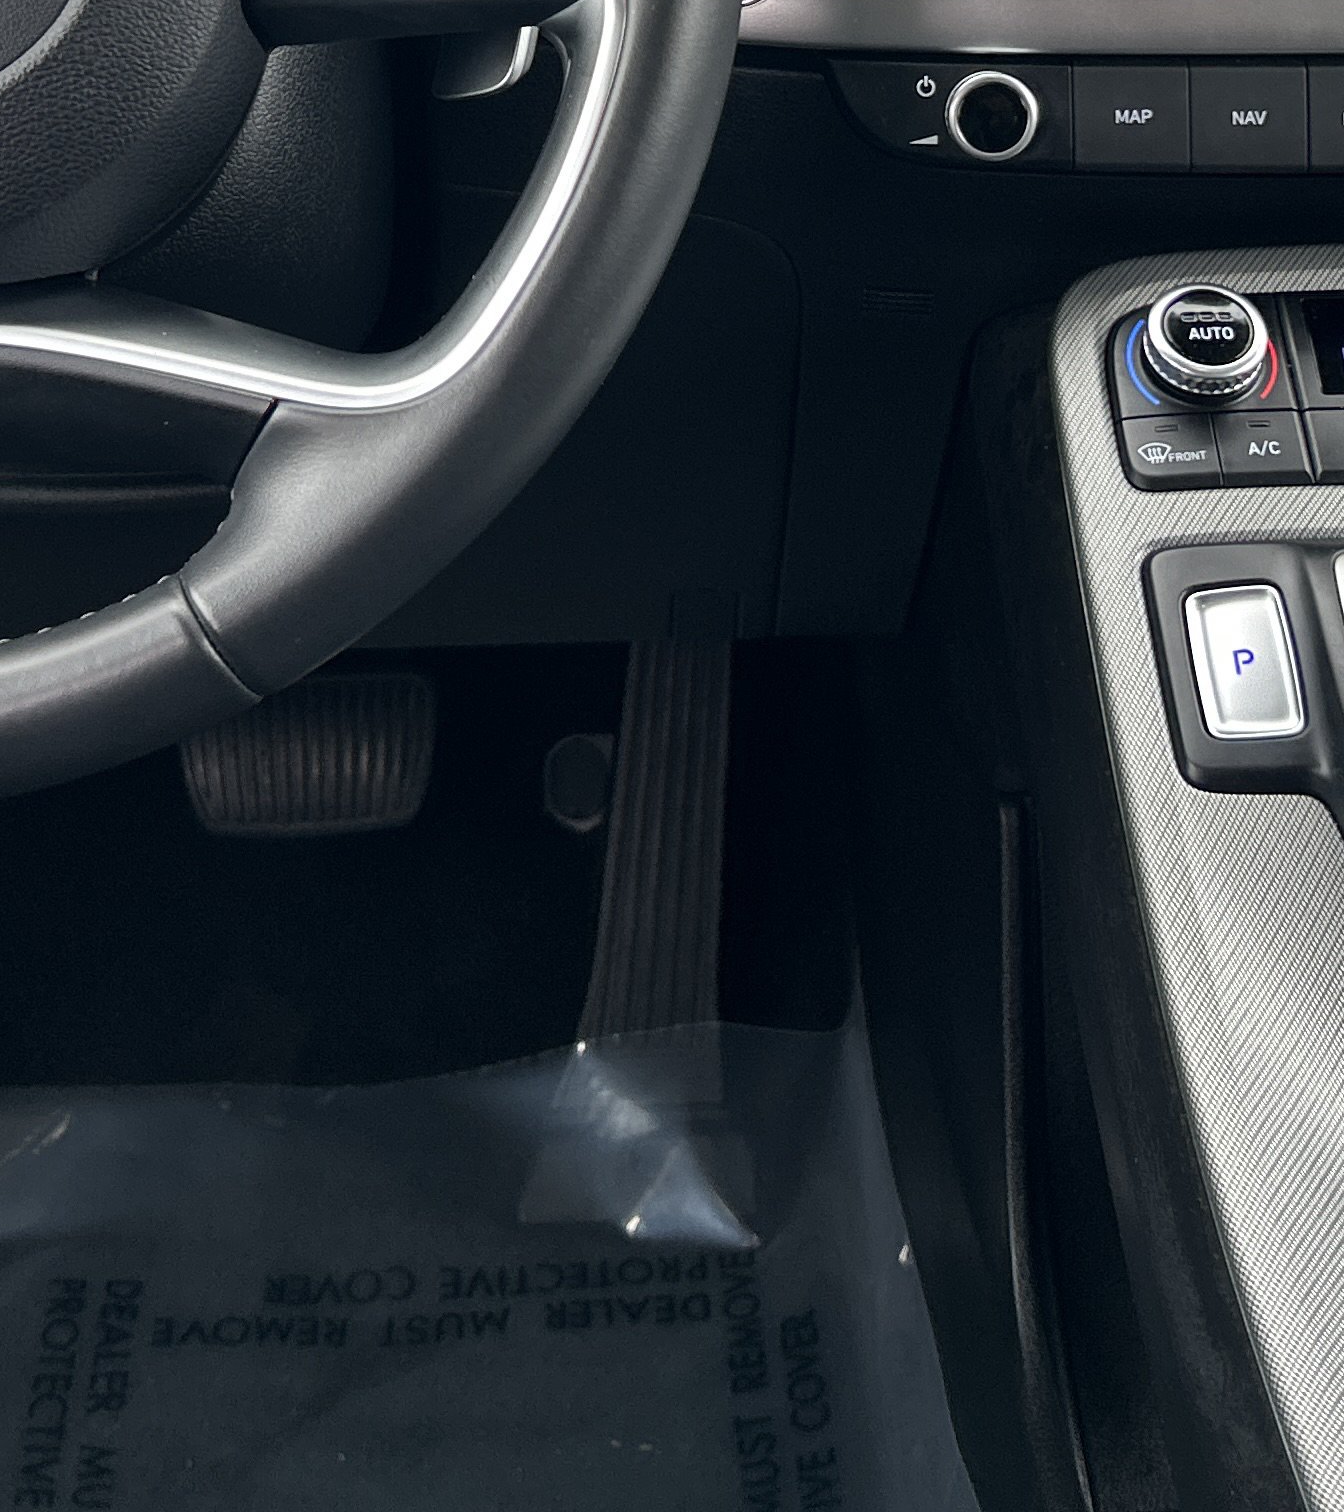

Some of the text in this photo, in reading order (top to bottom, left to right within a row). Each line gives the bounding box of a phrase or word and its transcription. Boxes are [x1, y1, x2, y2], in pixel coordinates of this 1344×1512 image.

[1115, 109, 1152, 123] MAP
[1232, 111, 1267, 125] NAV
[1189, 327, 1234, 340] AUTO
[1169, 449, 1206, 462] FRONT
[1249, 441, 1280, 456] A/C
[1233, 649, 1254, 675] P
[151, 1293, 712, 1348] DEALER MUST REMOVE
[84, 1278, 145, 1414] DEALER
[13, 1278, 87, 1509] PROTECTIVE
